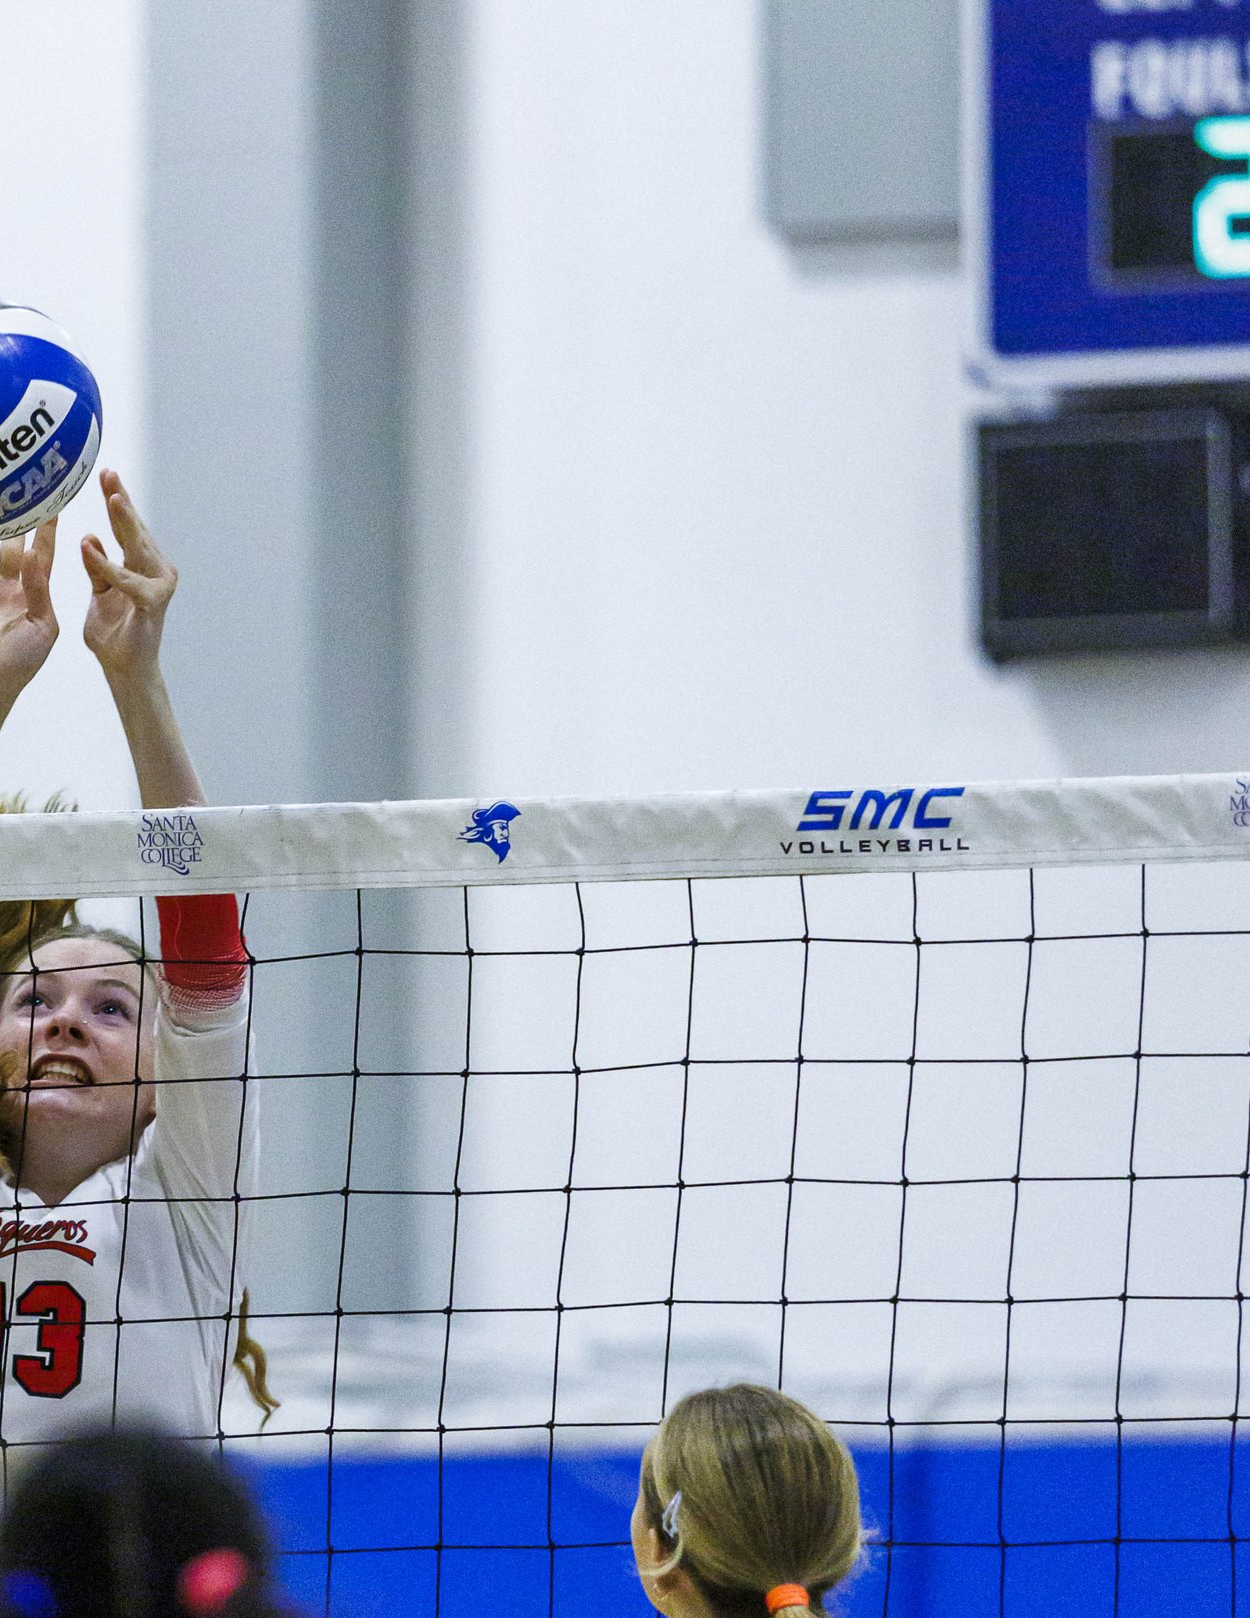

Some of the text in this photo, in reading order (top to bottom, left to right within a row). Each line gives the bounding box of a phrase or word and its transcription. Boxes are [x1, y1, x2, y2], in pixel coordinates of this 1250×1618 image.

[1089, 40, 1250, 119] FOUL
[796, 786, 966, 832] SMC
[141, 812, 197, 832] SANTA
[136, 831, 204, 848] MONICA
[780, 838, 970, 855] VOLLEYBALL
[141, 846, 203, 876] COLLEGE
